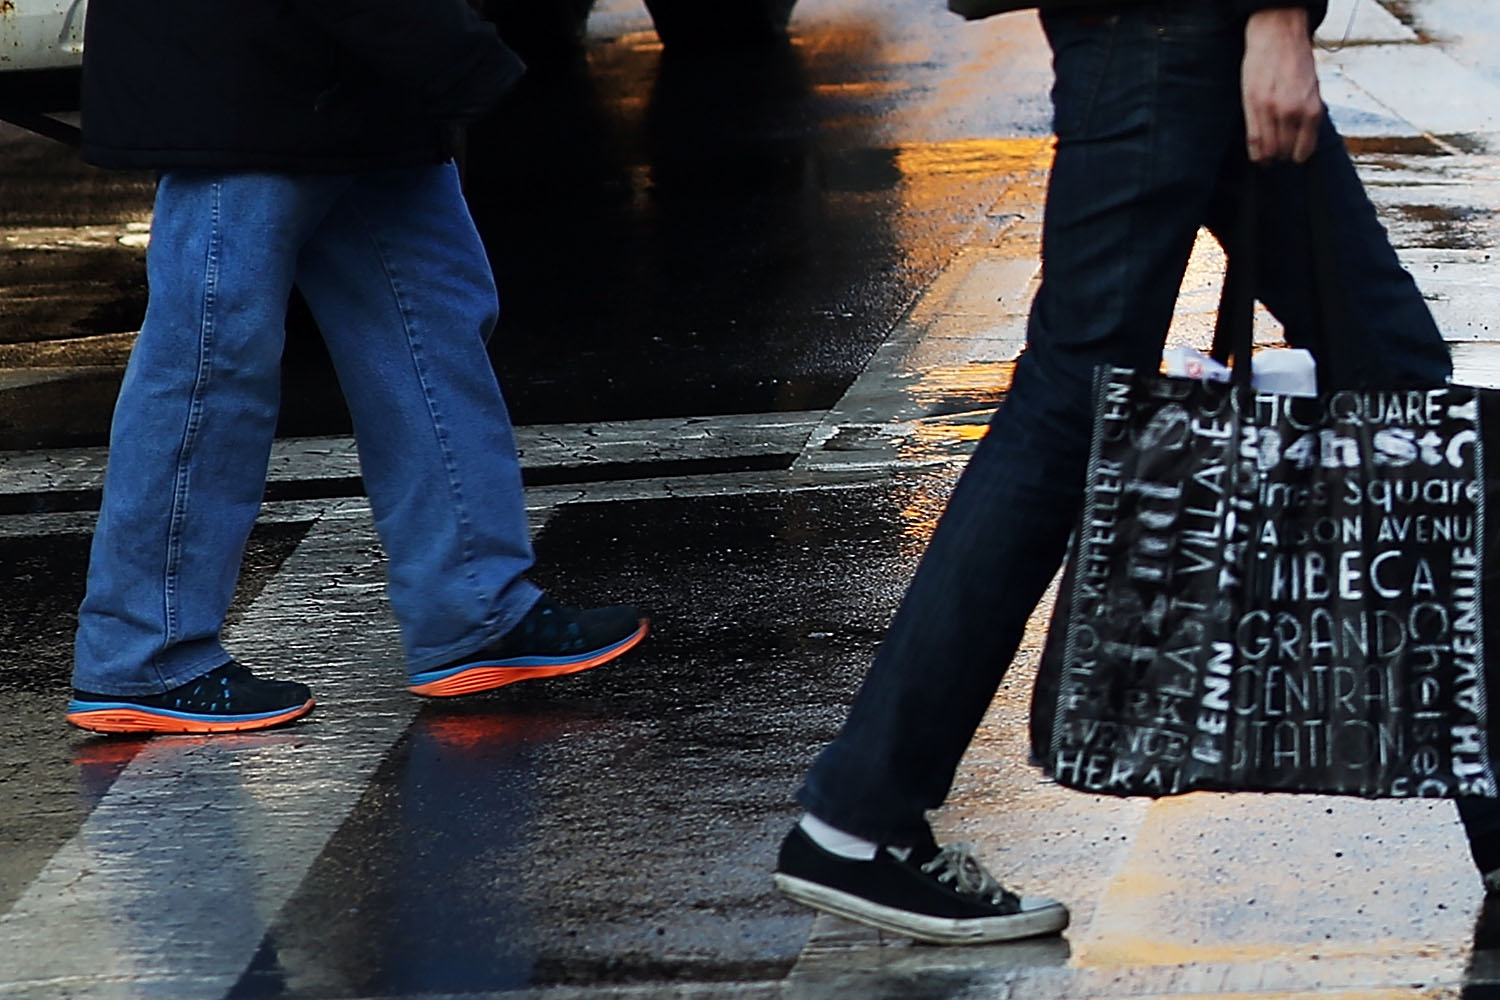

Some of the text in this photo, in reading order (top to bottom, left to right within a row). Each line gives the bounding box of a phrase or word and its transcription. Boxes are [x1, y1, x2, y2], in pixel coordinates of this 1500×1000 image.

[1236, 607, 1408, 661] GRAND
[1451, 547, 1483, 713] AVENUE
[1192, 640, 1233, 764] PENN
[1231, 664, 1402, 716] CENTRAL
[1230, 719, 1405, 771] STATION
